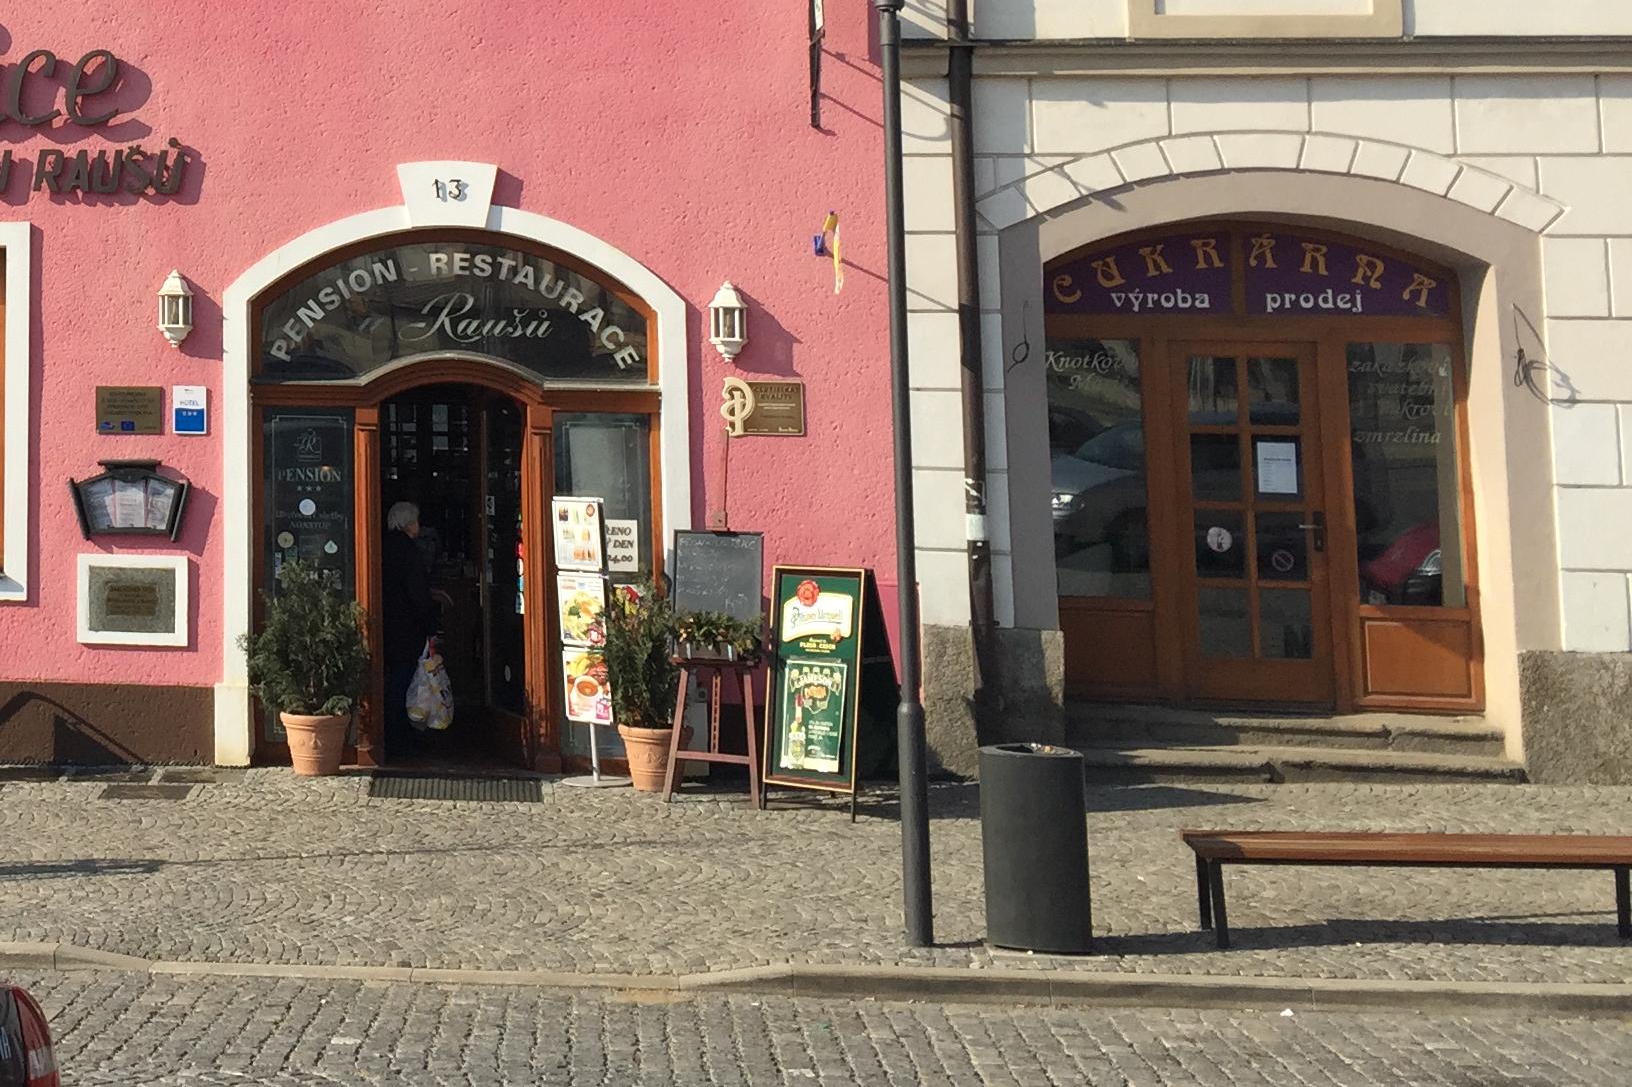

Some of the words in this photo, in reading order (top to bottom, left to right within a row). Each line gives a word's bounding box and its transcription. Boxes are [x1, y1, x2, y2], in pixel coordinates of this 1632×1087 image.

[32, 137, 186, 196] RAUŠŮ
[431, 178, 463, 201] 13
[1053, 233, 1437, 309] CUKRÁRNA
[270, 259, 399, 363] PENSION
[429, 252, 641, 371] RESTAURACE
[397, 291, 555, 344] Raušů
[1110, 288, 1212, 313] výroba
[1266, 288, 1364, 313] prodej
[278, 467, 342, 483] PENSION
